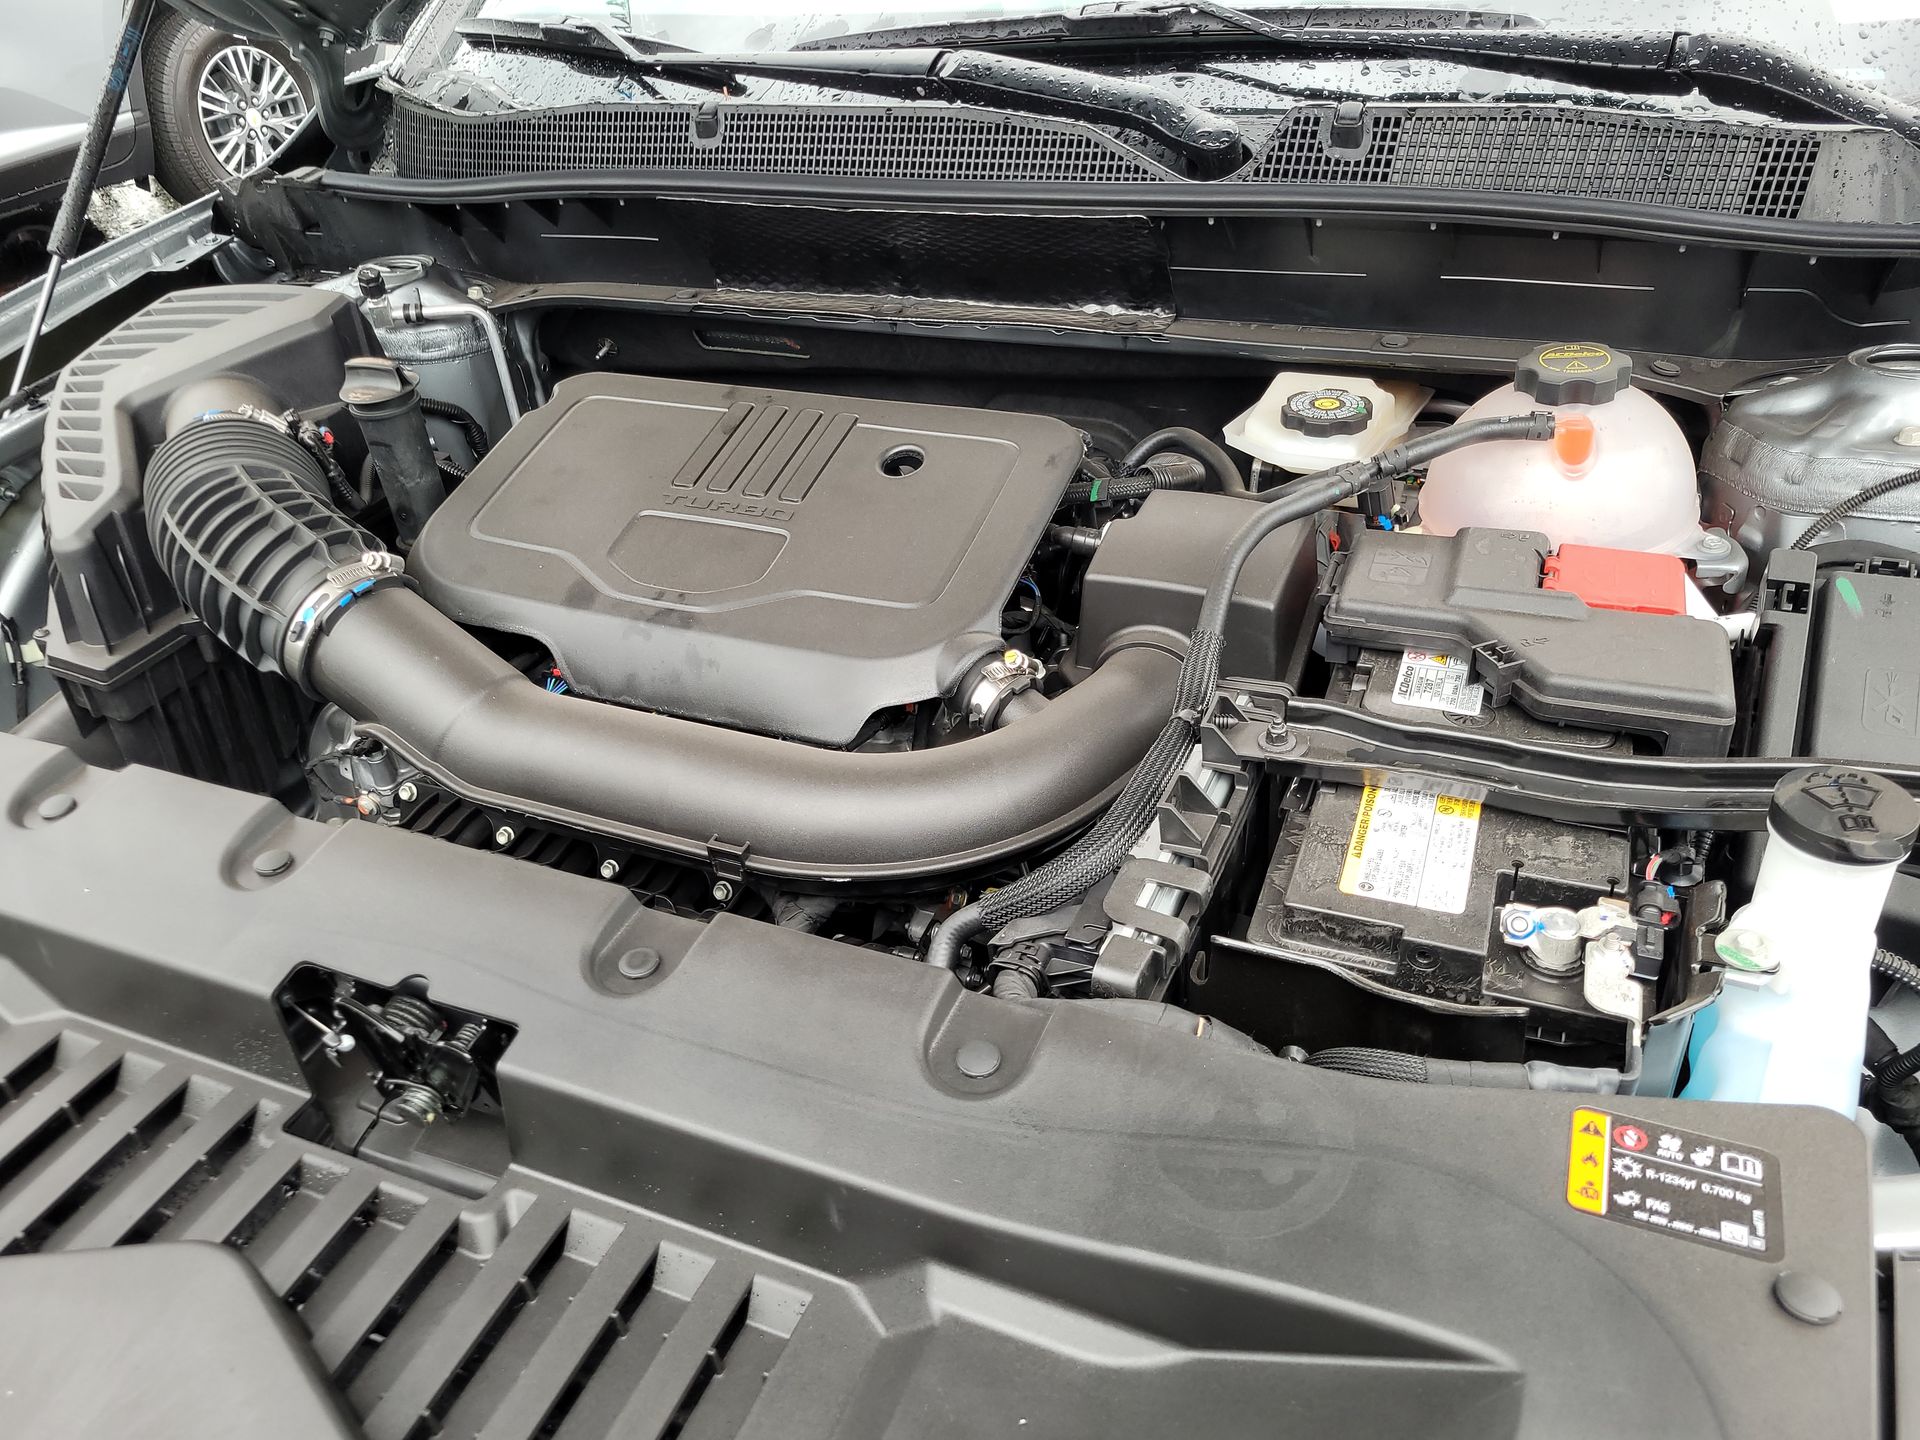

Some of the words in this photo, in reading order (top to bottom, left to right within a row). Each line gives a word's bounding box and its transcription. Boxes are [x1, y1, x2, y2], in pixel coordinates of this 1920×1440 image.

[663, 494, 795, 521] TURBO
[1424, 679, 1434, 694] 7287
[1353, 787, 1378, 854] DANGER/POISON
[1656, 1149, 1684, 1162] AUTO
[1645, 1168, 1697, 1190] R-1234yf
[1701, 1183, 1734, 1200] 0.700
[1735, 1191, 1752, 1205] kg
[1645, 1197, 1672, 1214] PAG
